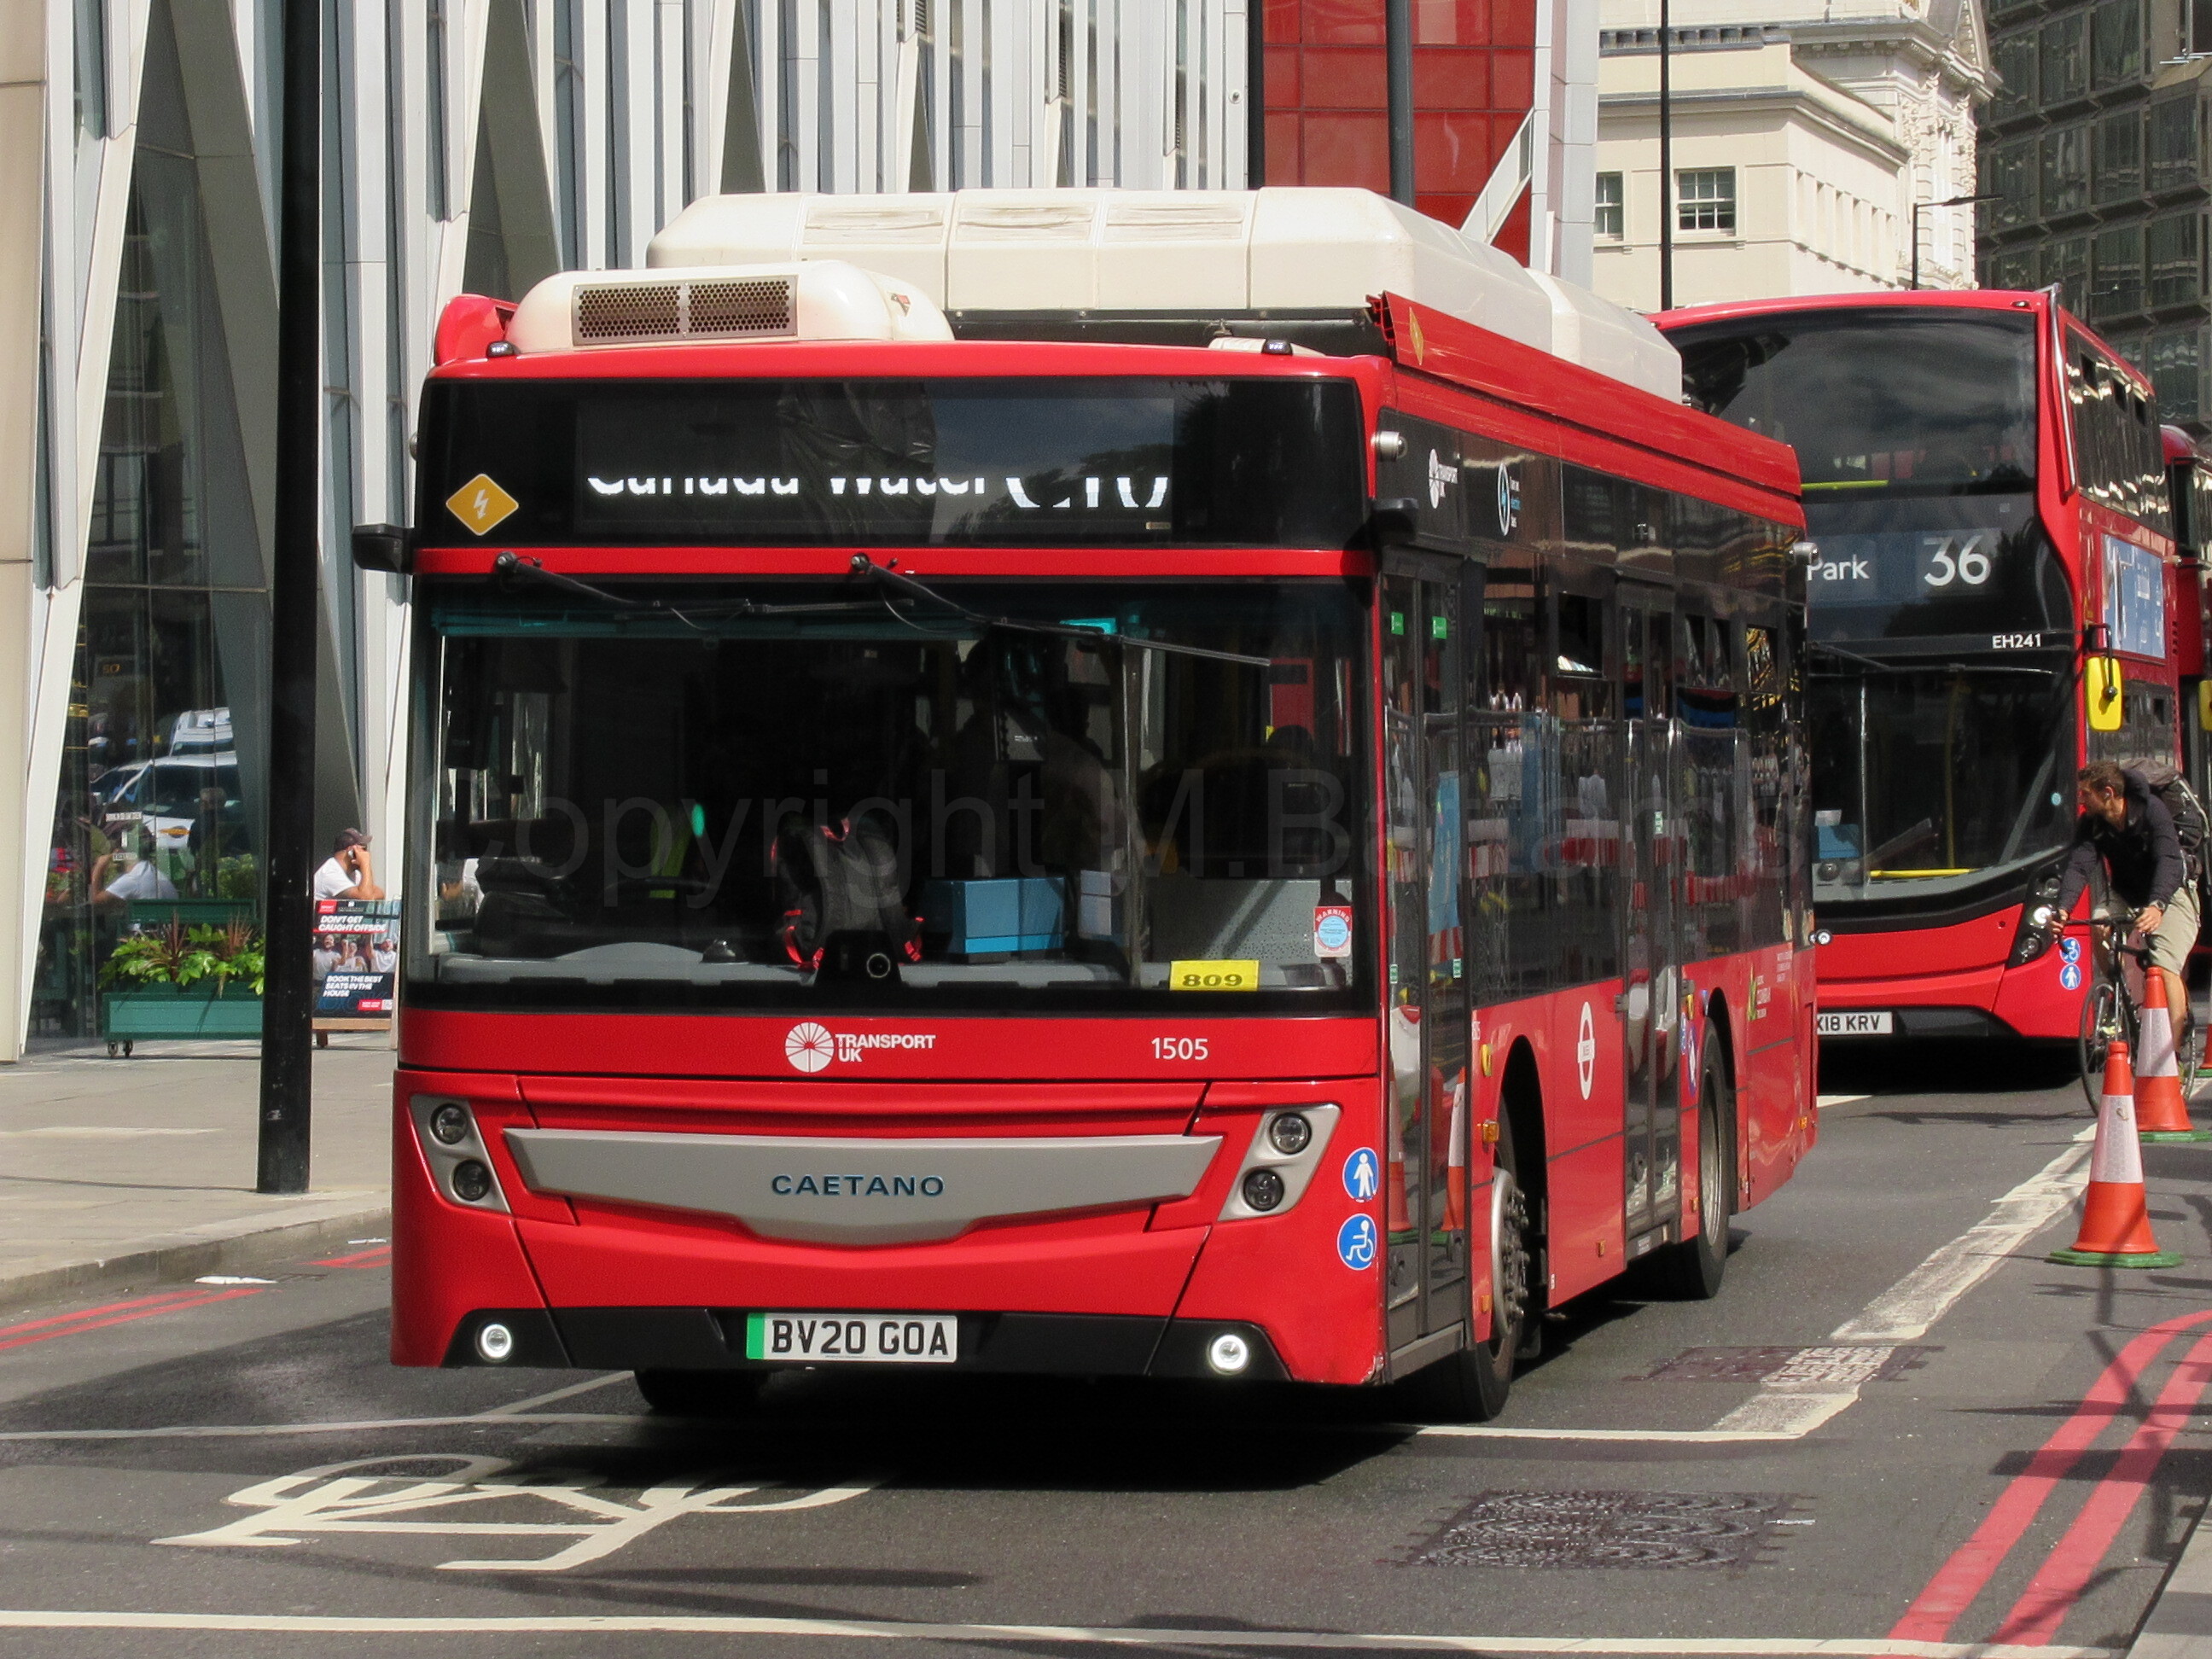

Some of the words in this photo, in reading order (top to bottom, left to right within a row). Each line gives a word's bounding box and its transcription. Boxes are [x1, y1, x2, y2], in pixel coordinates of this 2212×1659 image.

[1807, 554, 1870, 581] Park
[1923, 535, 1991, 587] 36
[1992, 633, 2041, 649] EH241
[1316, 909, 1350, 923] WARNING
[1183, 972, 1243, 987] 809
[1845, 1015, 1881, 1031] KRV
[835, 1033, 936, 1049] TRANSPORT
[838, 1048, 863, 1062] UK
[1152, 1038, 1208, 1061] 1505
[771, 1174, 945, 1197] CAETANO
[771, 1319, 866, 1354] BV20
[879, 1320, 948, 1356] GOA
